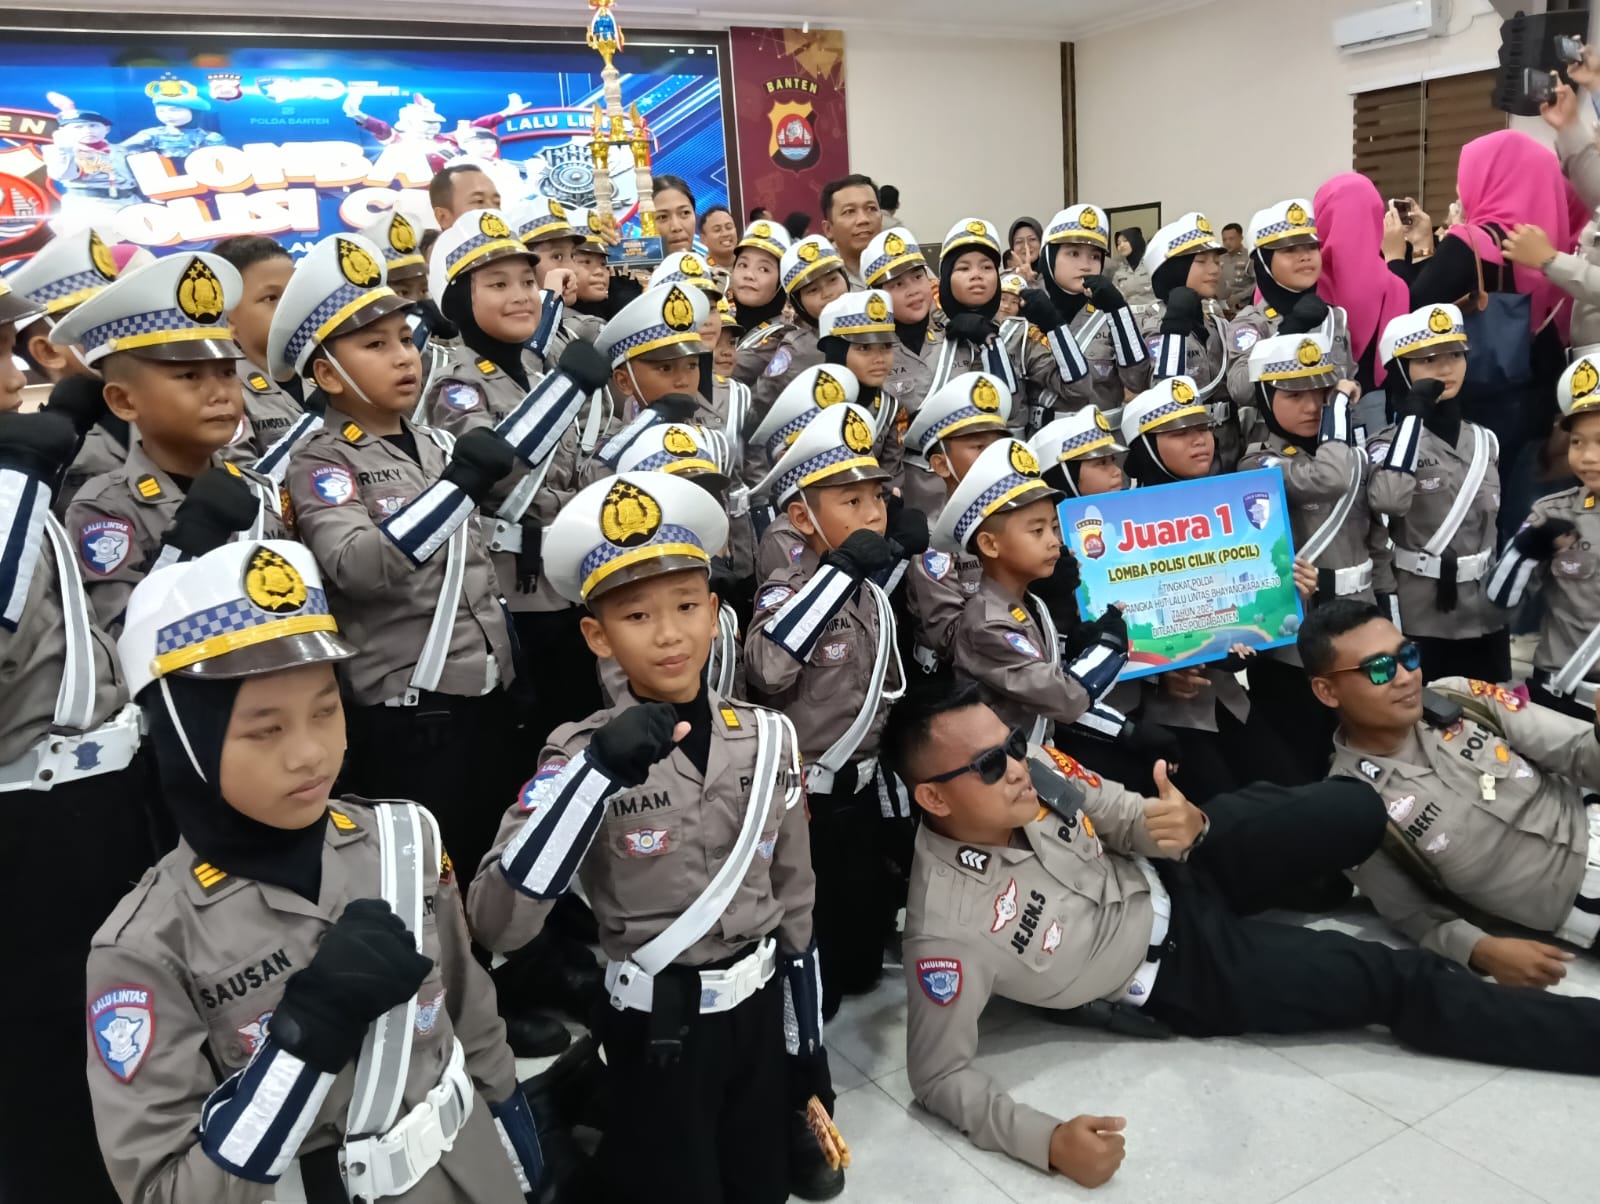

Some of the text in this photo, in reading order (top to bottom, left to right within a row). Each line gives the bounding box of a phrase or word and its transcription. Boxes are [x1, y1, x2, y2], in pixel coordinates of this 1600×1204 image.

[766, 77, 818, 94] BANTEN
[250, 117, 287, 126] POLDA
[506, 115, 559, 132] LALU
[126, 140, 436, 199] LOMBA
[358, 468, 403, 487] RIZKY
[1118, 504, 1234, 552] Juara 1
[1108, 544, 1261, 583] LOMBA POLISI CILIK (POCIL)
[1162, 575, 1215, 593] TINGKAT POLDA
[1212, 581, 1260, 597] BHAYANGKARA
[612, 791, 672, 818] IMAM
[1010, 889, 1047, 954] JEJEN.S
[202, 947, 293, 1009] SAUSAN
[92, 990, 149, 1015] LALU LINTAS
